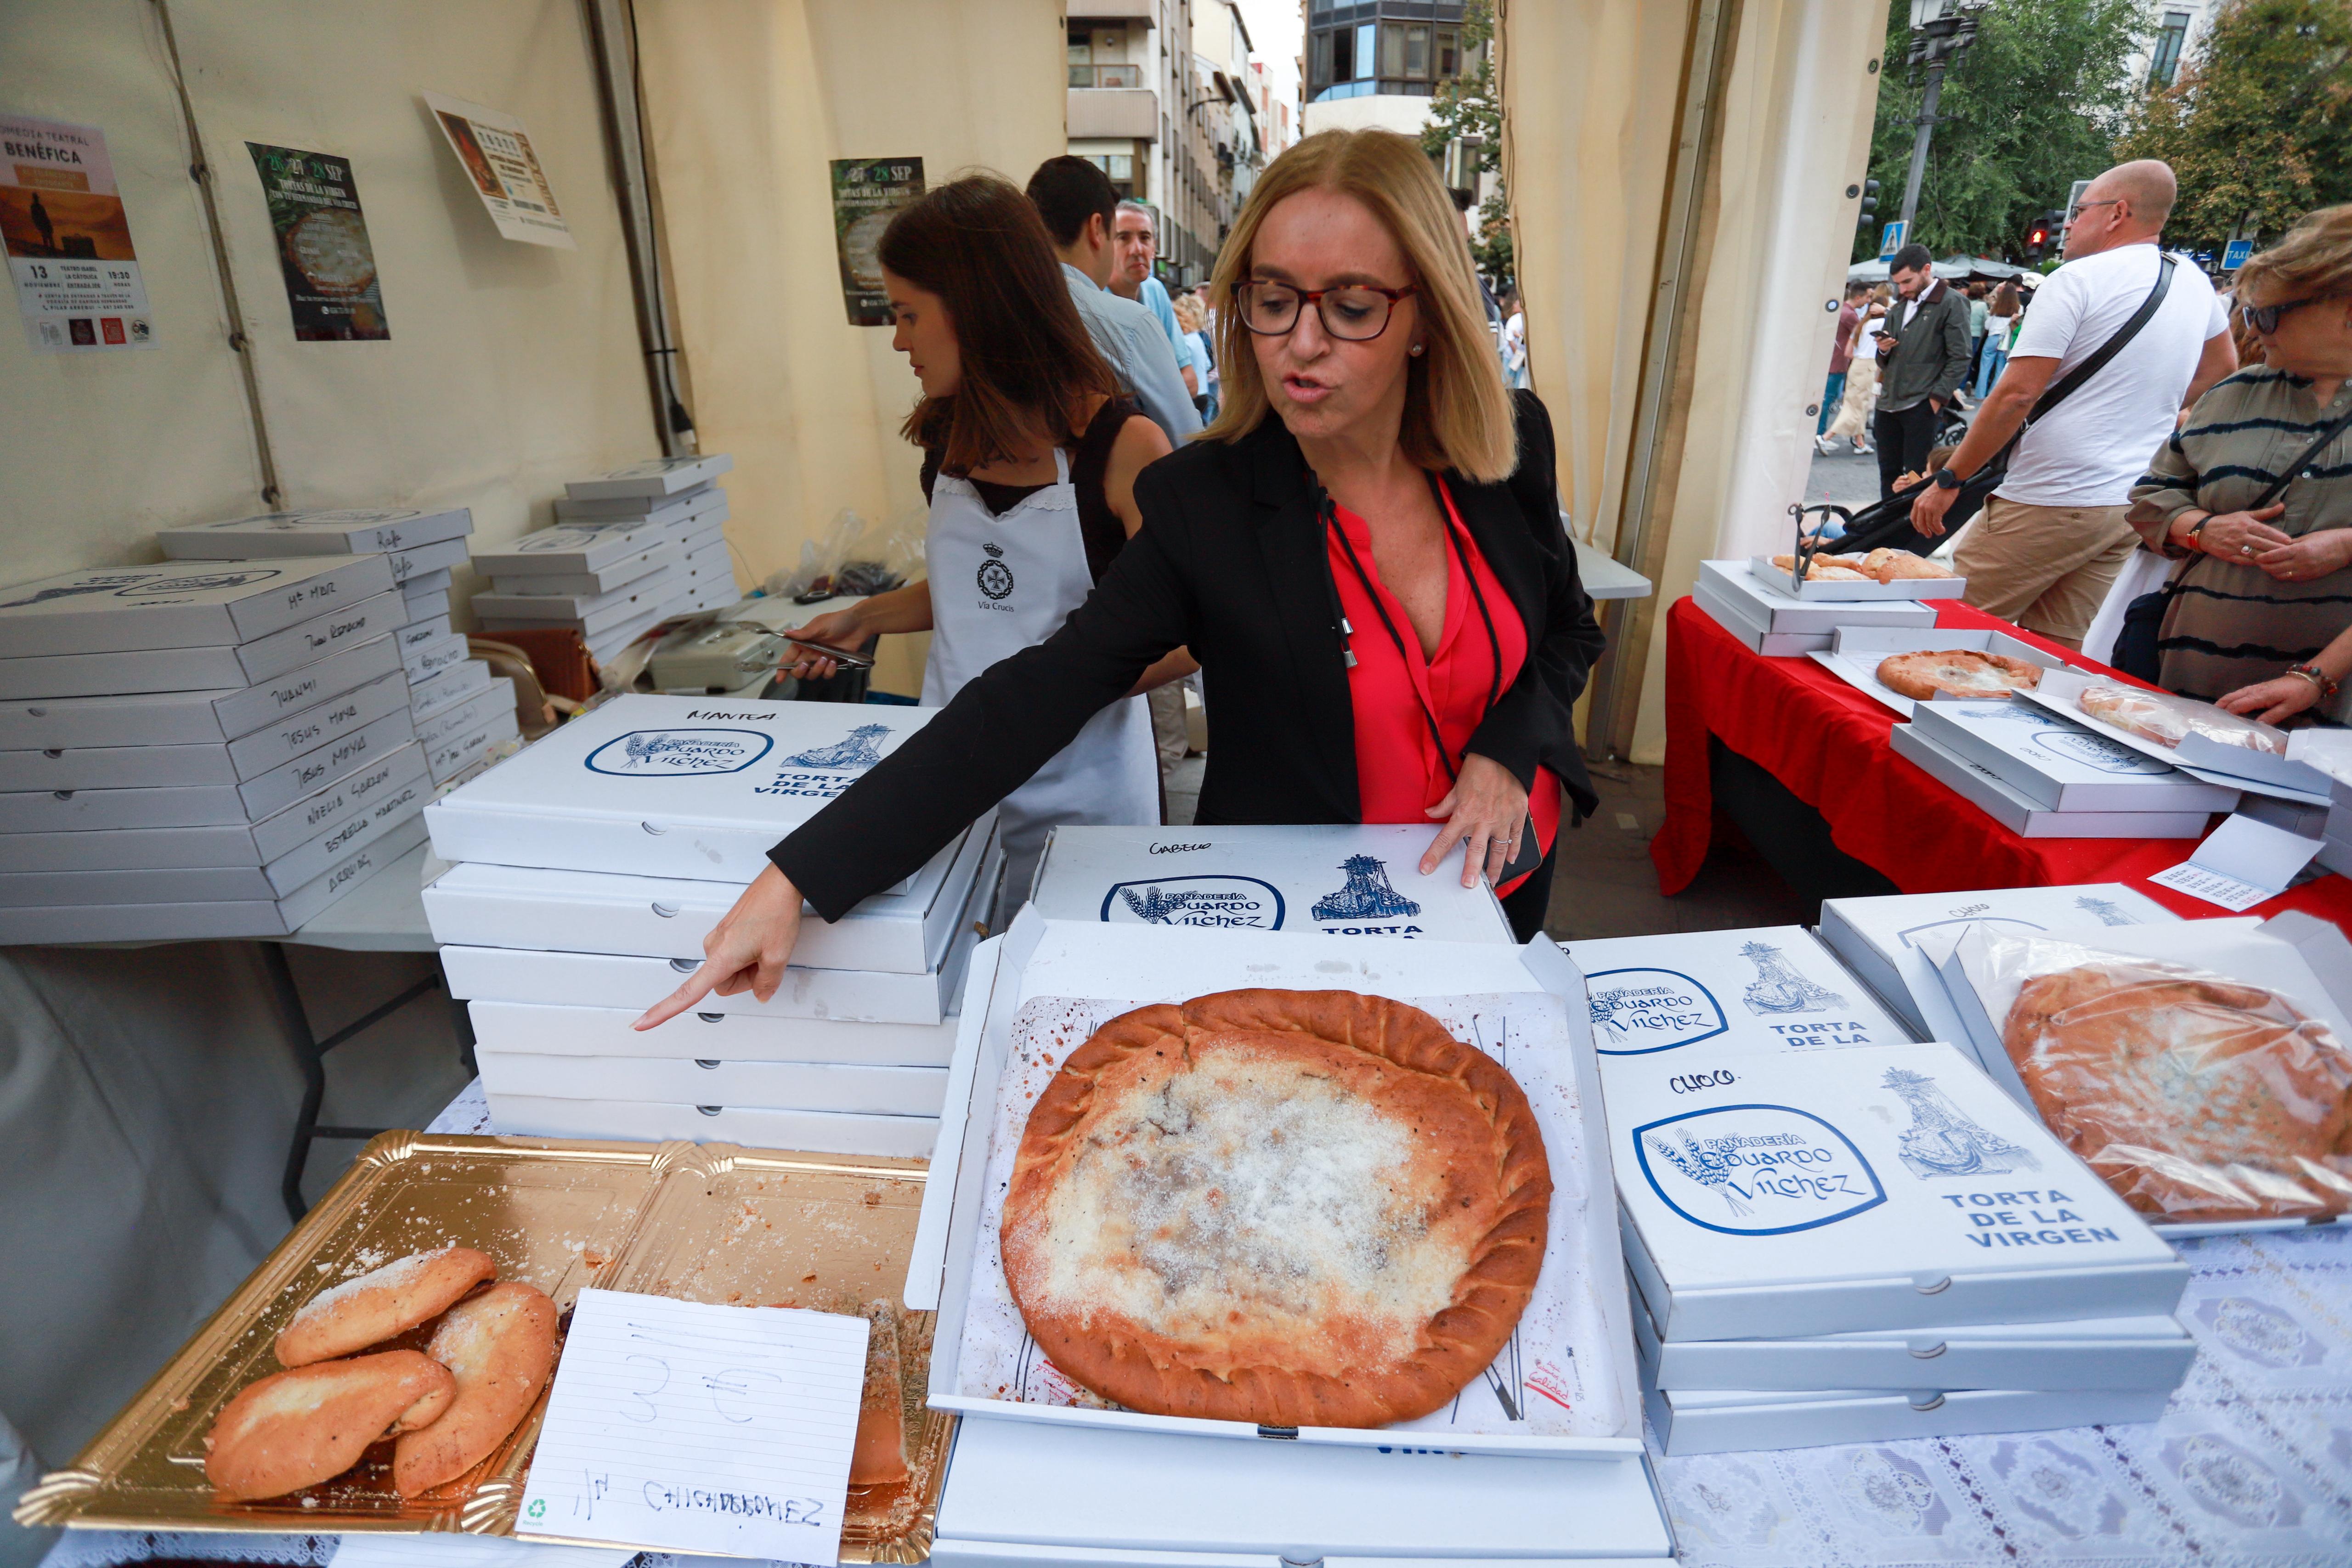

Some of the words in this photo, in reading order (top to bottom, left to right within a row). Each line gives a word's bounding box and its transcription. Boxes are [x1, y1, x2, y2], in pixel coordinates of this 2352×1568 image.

[5, 141, 82, 164] BENÉFICA
[324, 164, 342, 181] SEP
[850, 167, 865, 182] 27
[873, 166, 890, 181] 28
[890, 165, 913, 181] SEP
[30, 265, 48, 279] 13
[978, 601, 989, 610] Vía
[992, 602, 1014, 612] Crucis
[281, 725, 320, 750] JESUS
[667, 739, 740, 747] PANADERÍA
[332, 735, 367, 766] MOYA
[754, 787, 839, 798] VIRGE
[307, 795, 344, 825] NOELIA
[1322, 925, 1424, 935] TORTA
[1597, 987, 1674, 999] PANADERÍA
[1769, 1021, 1867, 1034] TORTA
[1786, 1036, 1826, 1046] DE
[1832, 1034, 1871, 1044] LA
[1704, 1133, 1807, 1150] PANADERÍA
[1941, 1190, 2075, 1208] TORTA
[1968, 1211, 2023, 1227] DE
[2029, 1209, 2085, 1224] LA
[1965, 1227, 2120, 1248] VIRGEN
[620, 1354, 671, 1423] 3
[702, 1368, 782, 1424] €
[1529, 1371, 1568, 1400] Calidad
